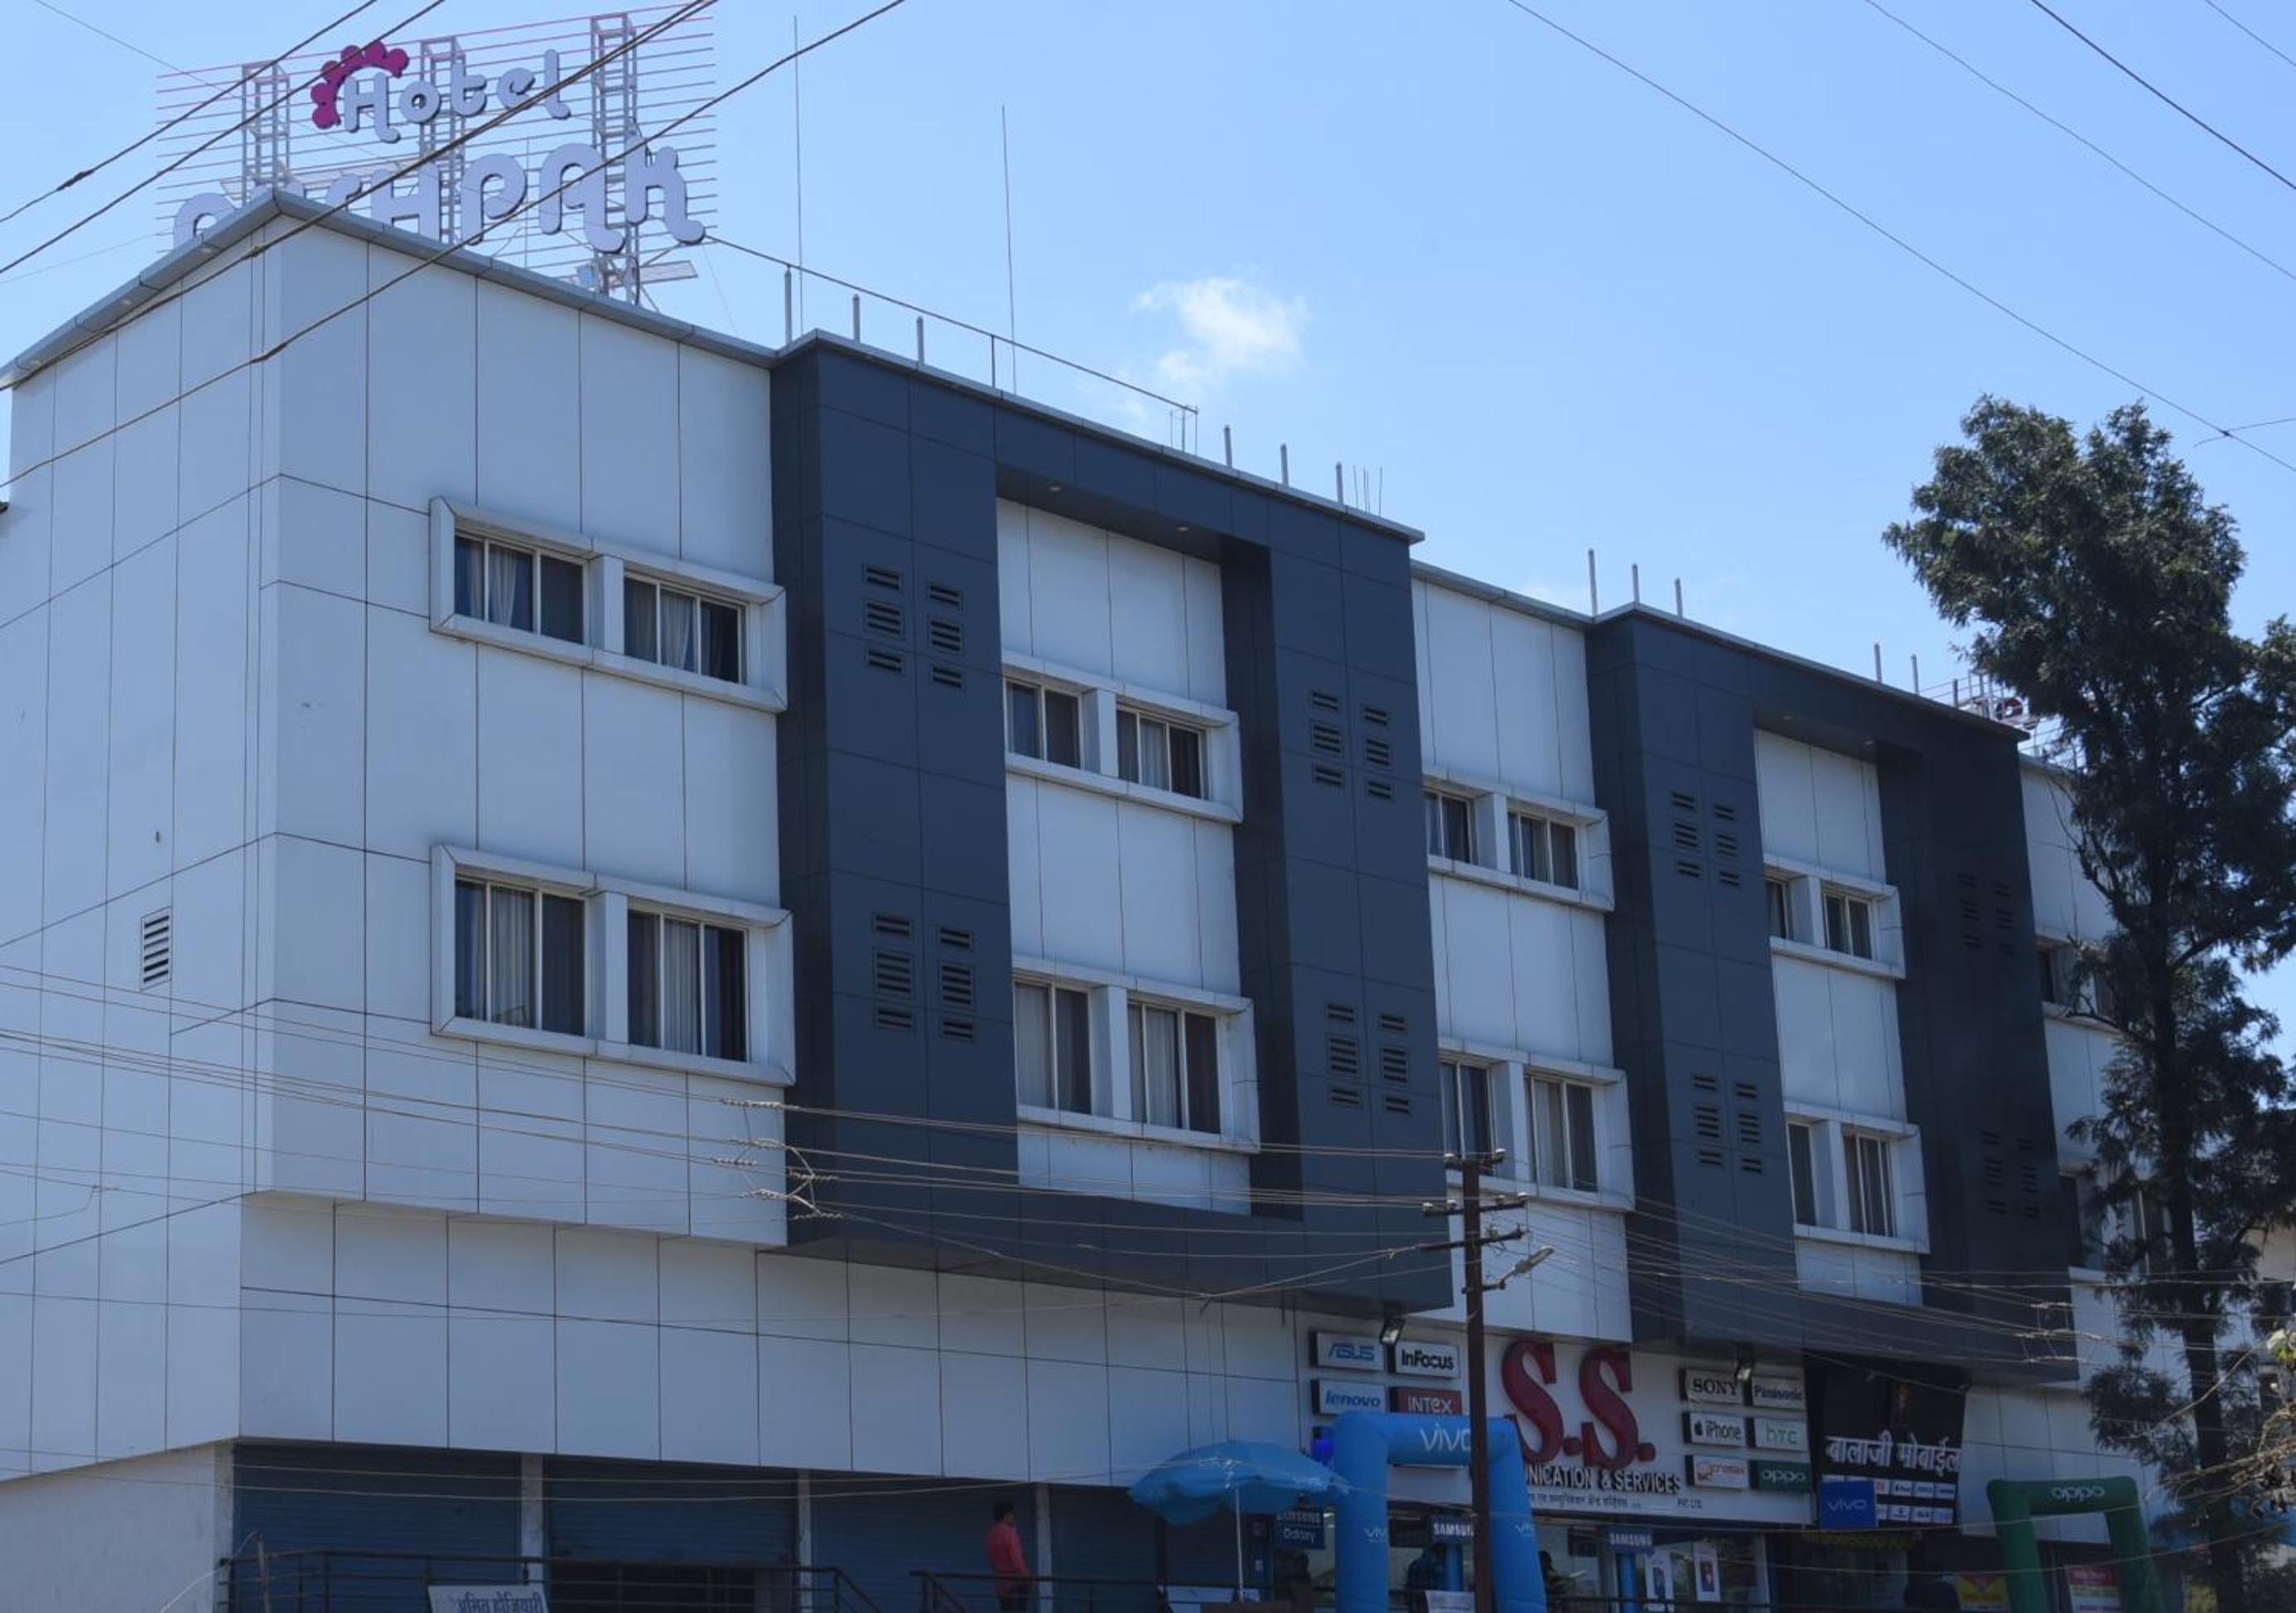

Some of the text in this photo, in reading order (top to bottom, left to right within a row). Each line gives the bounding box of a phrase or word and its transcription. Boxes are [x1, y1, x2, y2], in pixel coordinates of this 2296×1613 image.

[344, 49, 572, 144] Hotel
[1328, 1341, 1376, 1362] ASUS
[1401, 1347, 1455, 1371] InFocus
[1692, 1377, 1739, 1398] SONY
[1324, 1389, 1381, 1408] lenovo
[1705, 1419, 1743, 1442] iPhone
[1824, 1429, 1895, 1468] बालाजी
[1613, 1469, 1682, 1495] SERVICES
[1761, 1468, 1807, 1485] oppo
[2050, 1484, 2106, 1503] oppo
[1826, 1497, 1869, 1514] vivo
[1433, 1522, 1474, 1538] SAMSUN
[1609, 1530, 1653, 1547] SAMSUNG
